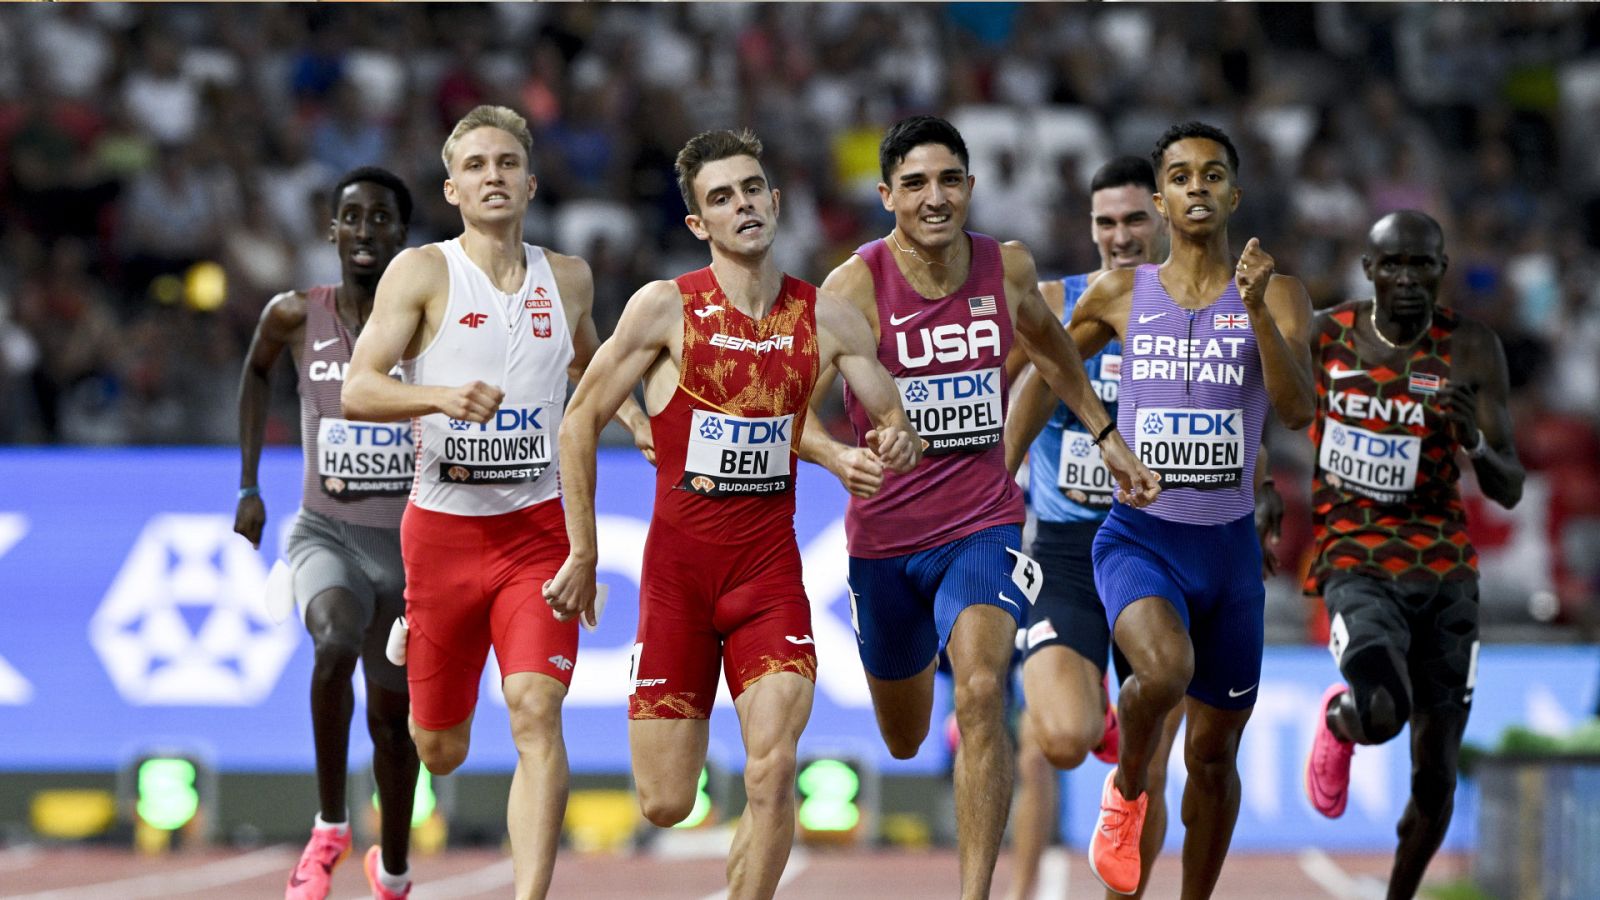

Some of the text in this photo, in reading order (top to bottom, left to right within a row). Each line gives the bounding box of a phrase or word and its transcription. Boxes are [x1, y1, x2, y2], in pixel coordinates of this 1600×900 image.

[459, 312, 488, 329] 4F
[709, 334, 794, 354] ESPAÑA
[896, 320, 1000, 368] USA
[1133, 335, 1246, 358] GREAT
[1132, 360, 1244, 386] BRITAIN
[928, 372, 995, 400] TDK
[480, 408, 543, 431] DK
[905, 402, 997, 432] HOPPEL
[1328, 390, 1426, 427] KENYA
[348, 425, 414, 446] TDK
[724, 419, 789, 444] TDK
[1164, 413, 1237, 435] TDK
[444, 435, 545, 462] OSTROWSKI
[933, 436, 991, 449] BUDAPEST
[1140, 442, 1239, 466] ROWDEN
[1347, 430, 1410, 460] TDK
[325, 452, 415, 474] HASSAN
[719, 449, 769, 475] BEN
[1328, 449, 1405, 487] ROTICH
[473, 469, 532, 479] BUDAPEST
[1165, 473, 1236, 483] BUDAPEST 23
[347, 481, 403, 491] BUDAPEST
[718, 482, 786, 492] BUDAPEST 23
[548, 655, 573, 671] 4F
[636, 678, 667, 687] ESP
